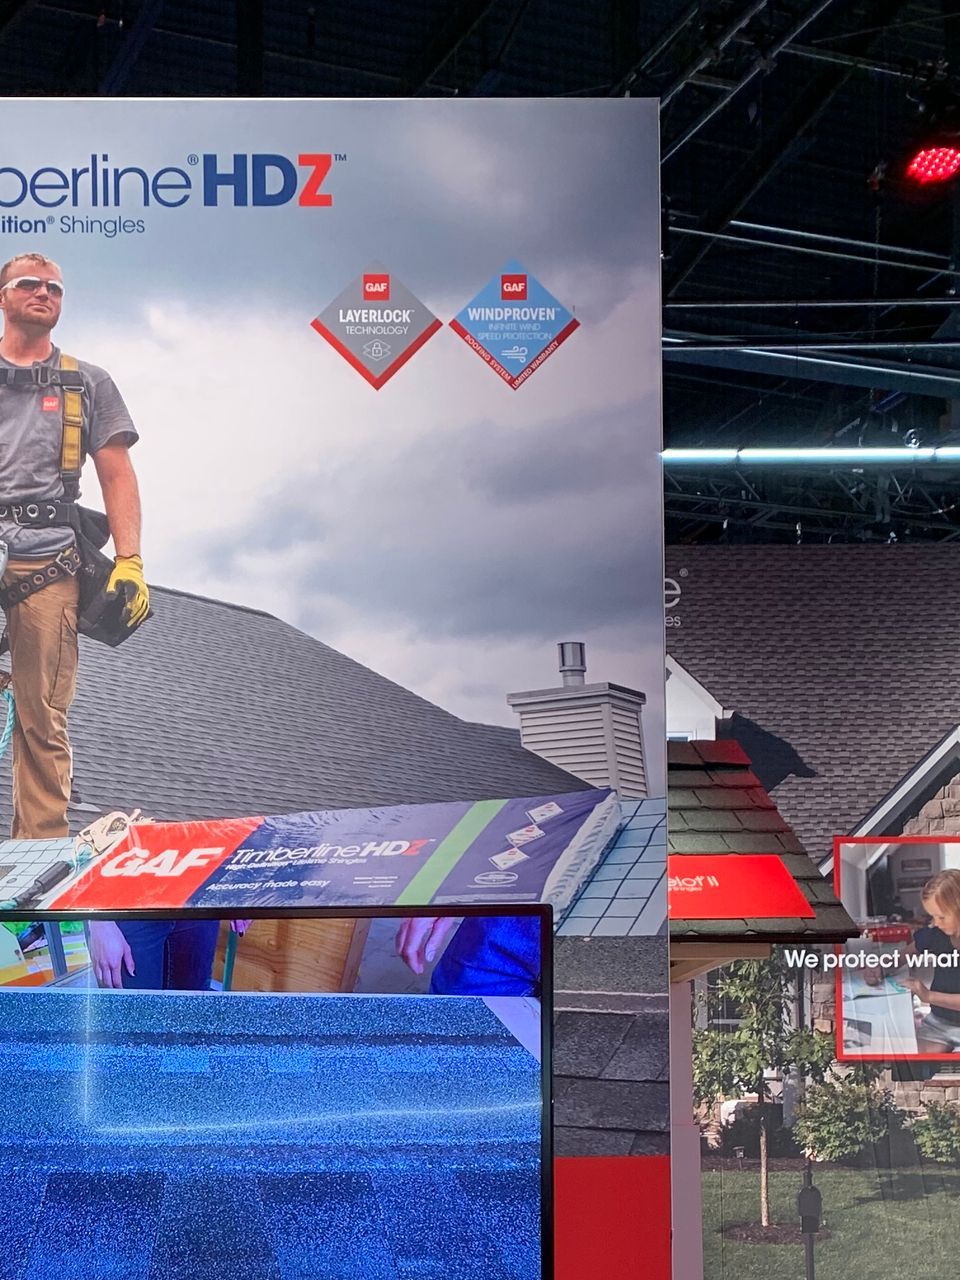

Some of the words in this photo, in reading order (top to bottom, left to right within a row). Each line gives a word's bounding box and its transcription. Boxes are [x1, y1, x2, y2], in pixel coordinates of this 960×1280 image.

[60, 215, 145, 238] Shingles
[365, 283, 388, 293] GAF
[503, 282, 526, 292] GAF
[345, 325, 408, 335] TECHNOLOGY
[519, 323, 541, 331] WIND
[464, 334, 491, 362] ROOFING
[489, 357, 512, 381] SYSTEM
[511, 368, 533, 389] LIMITED
[530, 340, 560, 370] WARRANTY
[100, 847, 226, 877] GAF
[328, 857, 368, 865] Shingles
[206, 881, 263, 891] Accuracy
[263, 879, 299, 889] made
[300, 879, 331, 888] easy
[784, 949, 819, 968] We
[823, 949, 900, 972] protect
[905, 949, 960, 968] what
